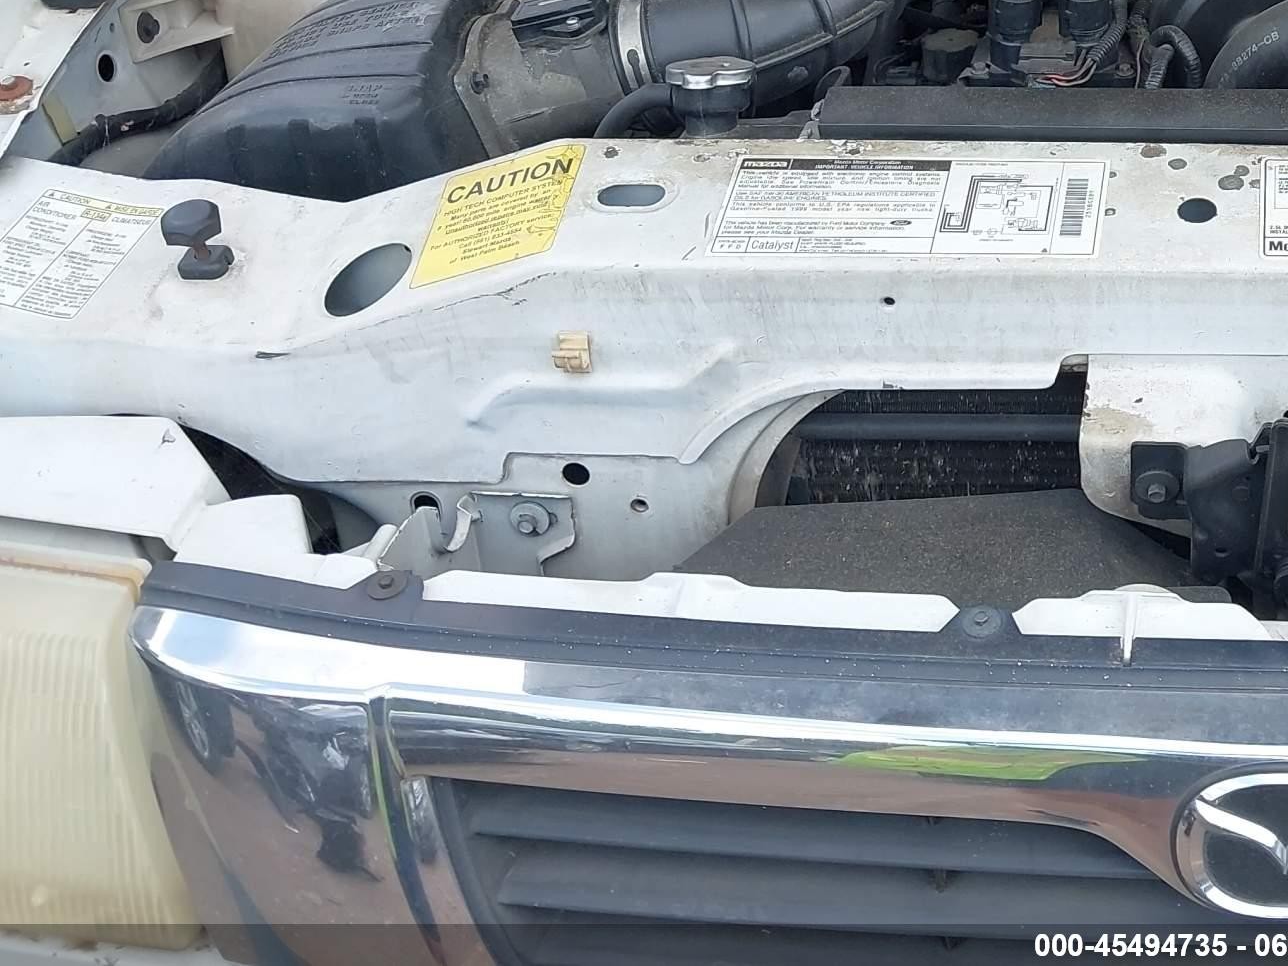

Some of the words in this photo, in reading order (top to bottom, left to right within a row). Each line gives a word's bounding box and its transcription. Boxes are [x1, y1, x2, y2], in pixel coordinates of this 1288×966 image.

[447, 158, 574, 203] CAUTION
[60, 193, 91, 205] CAUTION
[444, 207, 463, 217] HIGH
[465, 200, 485, 210] TECH
[486, 188, 530, 204] COMPUTER
[443, 230, 489, 247] AUTHORIZED
[490, 220, 526, 234] FACTORY
[751, 239, 794, 251] Catalyst
